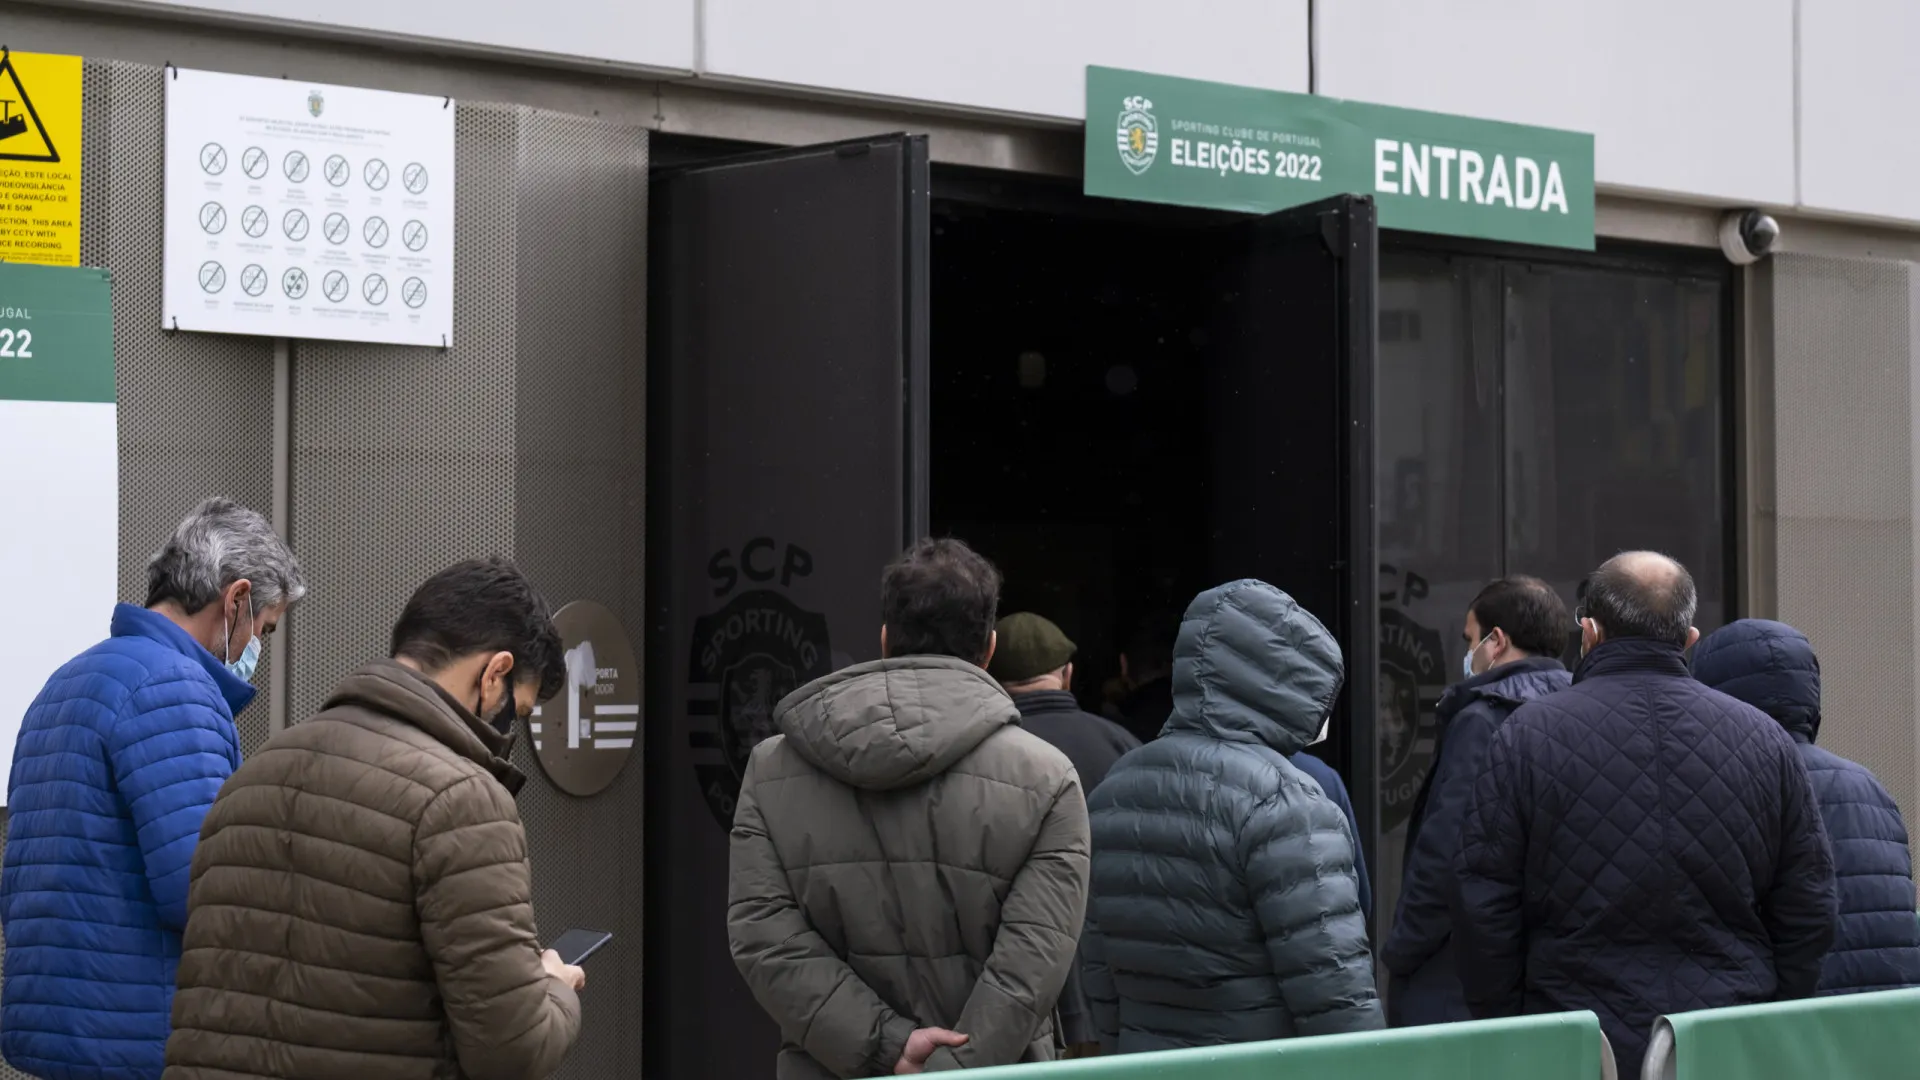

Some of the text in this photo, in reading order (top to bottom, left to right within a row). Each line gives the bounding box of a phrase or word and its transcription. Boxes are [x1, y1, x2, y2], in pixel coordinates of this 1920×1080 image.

[1171, 119, 1321, 148] SPORTING CLUBE DE PORTUGAL
[1171, 138, 1322, 182] ELEIÇÕES 2022
[24, 171, 44, 179] ESTE
[47, 172, 72, 181] LOCAL
[1375, 138, 1569, 214] ENTRADA
[12, 193, 56, 203] GRAVAÇÃO
[15, 204, 33, 212] SOM
[32, 218, 50, 226] THIS
[51, 219, 73, 228] AREA
[13, 229, 35, 238] CCTV
[36, 230, 57, 238] WITH
[15, 240, 62, 250] RECORDING
[707, 537, 813, 598] SCP
[701, 608, 819, 673] SPORTING
